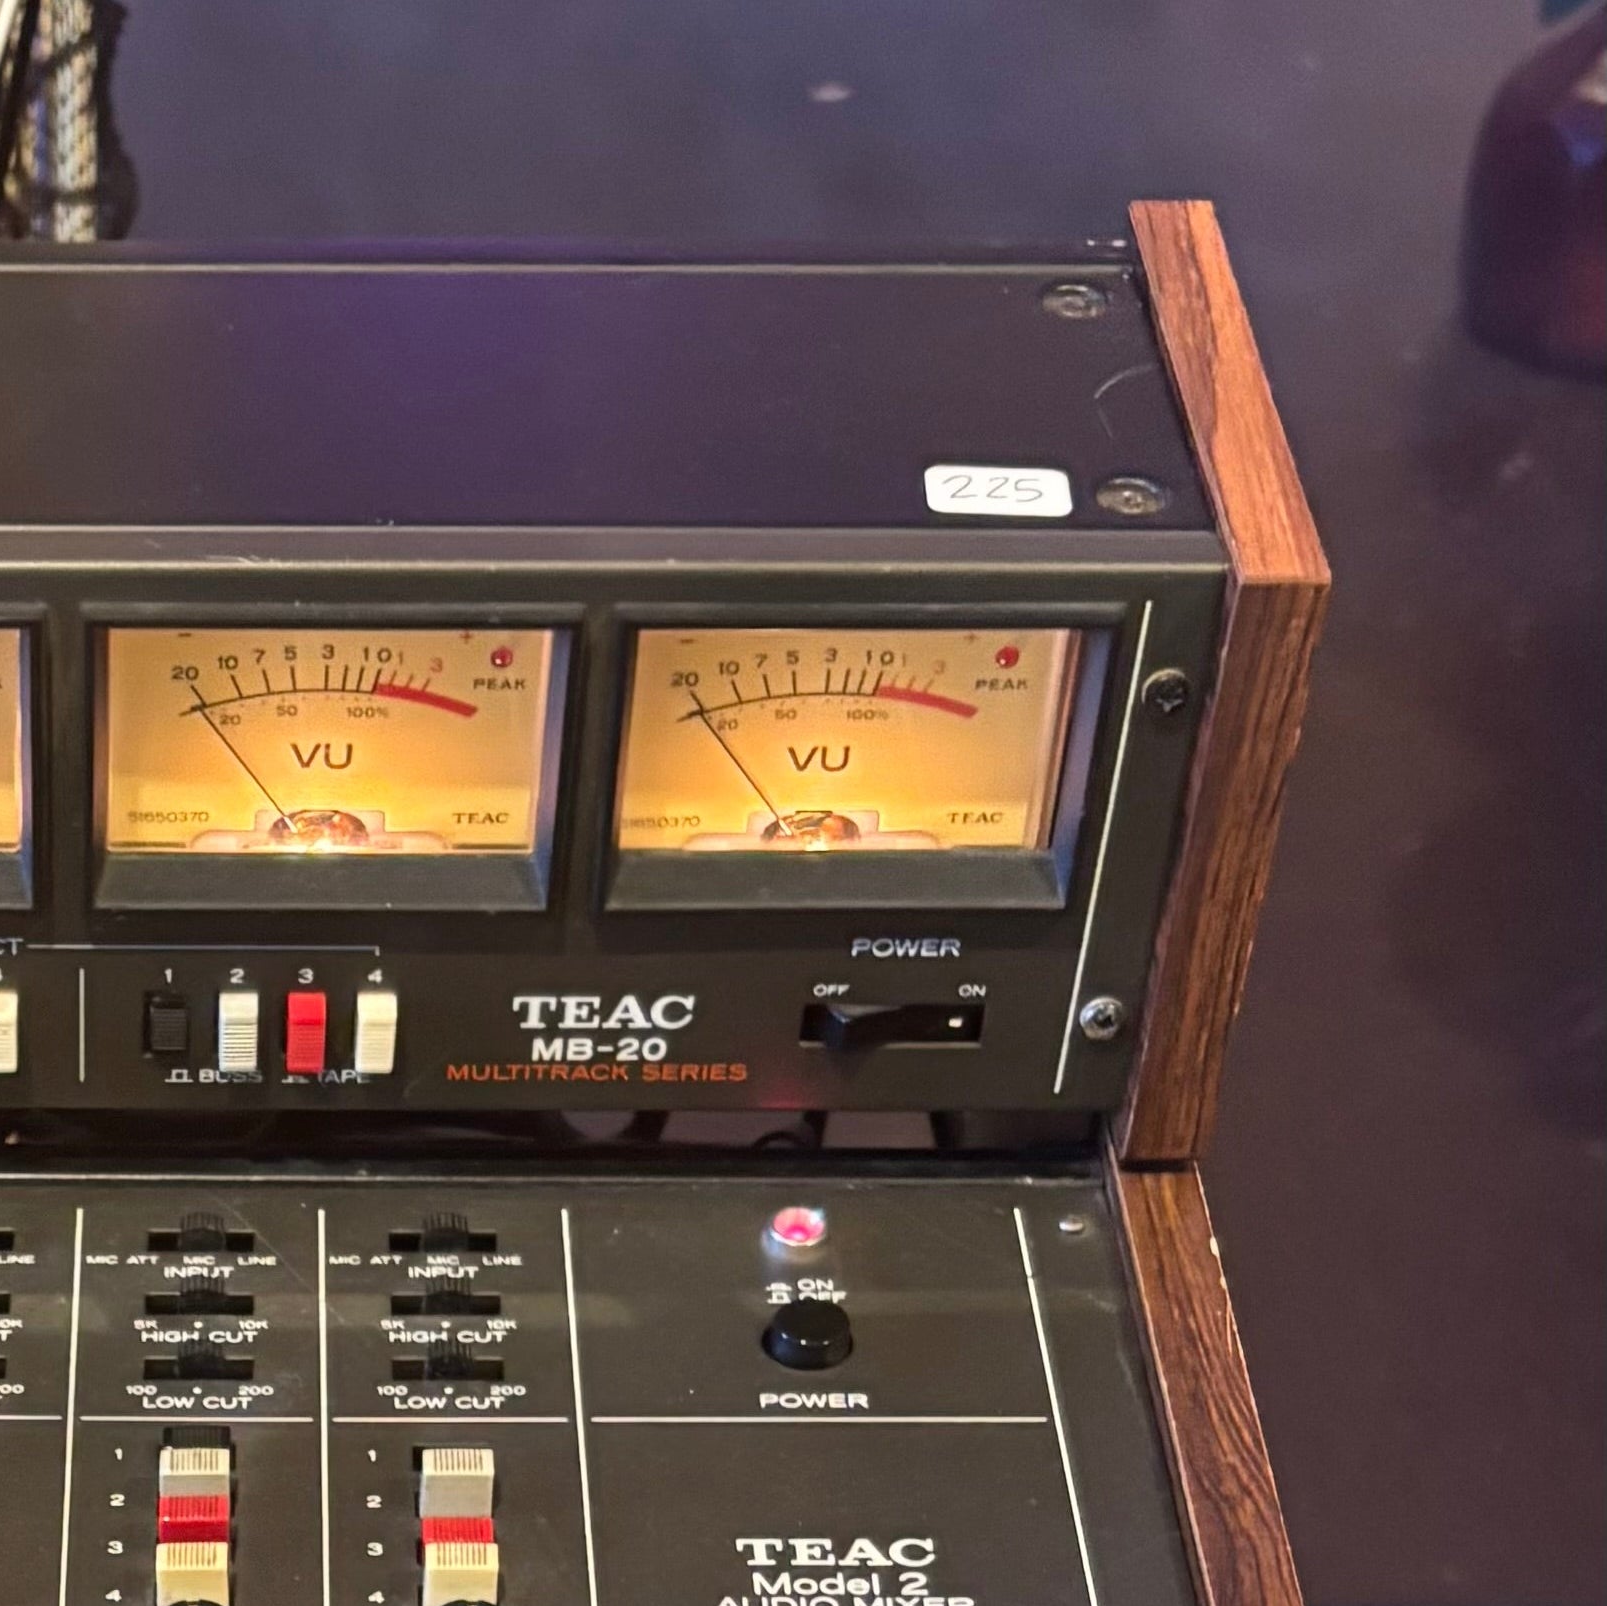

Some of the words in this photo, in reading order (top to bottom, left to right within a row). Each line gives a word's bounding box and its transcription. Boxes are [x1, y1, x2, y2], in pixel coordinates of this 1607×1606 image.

[942, 474, 1043, 502] 225
[472, 678, 526, 691] PEAK
[975, 678, 1029, 691] PEAK
[289, 742, 354, 770] VU
[787, 745, 851, 773] VU
[452, 812, 510, 825] TEAC
[946, 812, 1004, 824] TEAC
[852, 938, 962, 958] POWER
[165, 969, 173, 983] 1
[230, 969, 245, 984] 2
[298, 970, 314, 984] 3
[368, 970, 383, 984] 4
[813, 984, 850, 997] OFF
[958, 984, 987, 997] ON
[512, 995, 695, 1030] TEAC
[532, 1038, 668, 1062] MB-20
[447, 1064, 629, 1081] MULTITRACK
[642, 1064, 748, 1081] SERIES
[163, 1266, 235, 1278] INPUT
[408, 1267, 478, 1279] INPUT
[797, 1279, 834, 1291] ON
[140, 1331, 199, 1343] HIGH
[208, 1331, 258, 1343] CUT
[388, 1331, 448, 1343] HIGH
[457, 1331, 508, 1343] CUT
[126, 1385, 157, 1395] 100
[238, 1385, 274, 1396] 200
[377, 1385, 408, 1395] 100
[490, 1385, 526, 1396] 200
[142, 1397, 195, 1409] LOW
[202, 1397, 253, 1409] CUT
[394, 1397, 447, 1409] LOW
[454, 1397, 506, 1409] CUT
[759, 1393, 869, 1409] POWER
[735, 1539, 936, 1567] TEAC
[753, 1572, 881, 1596] Model
[899, 1572, 929, 1596] 2
